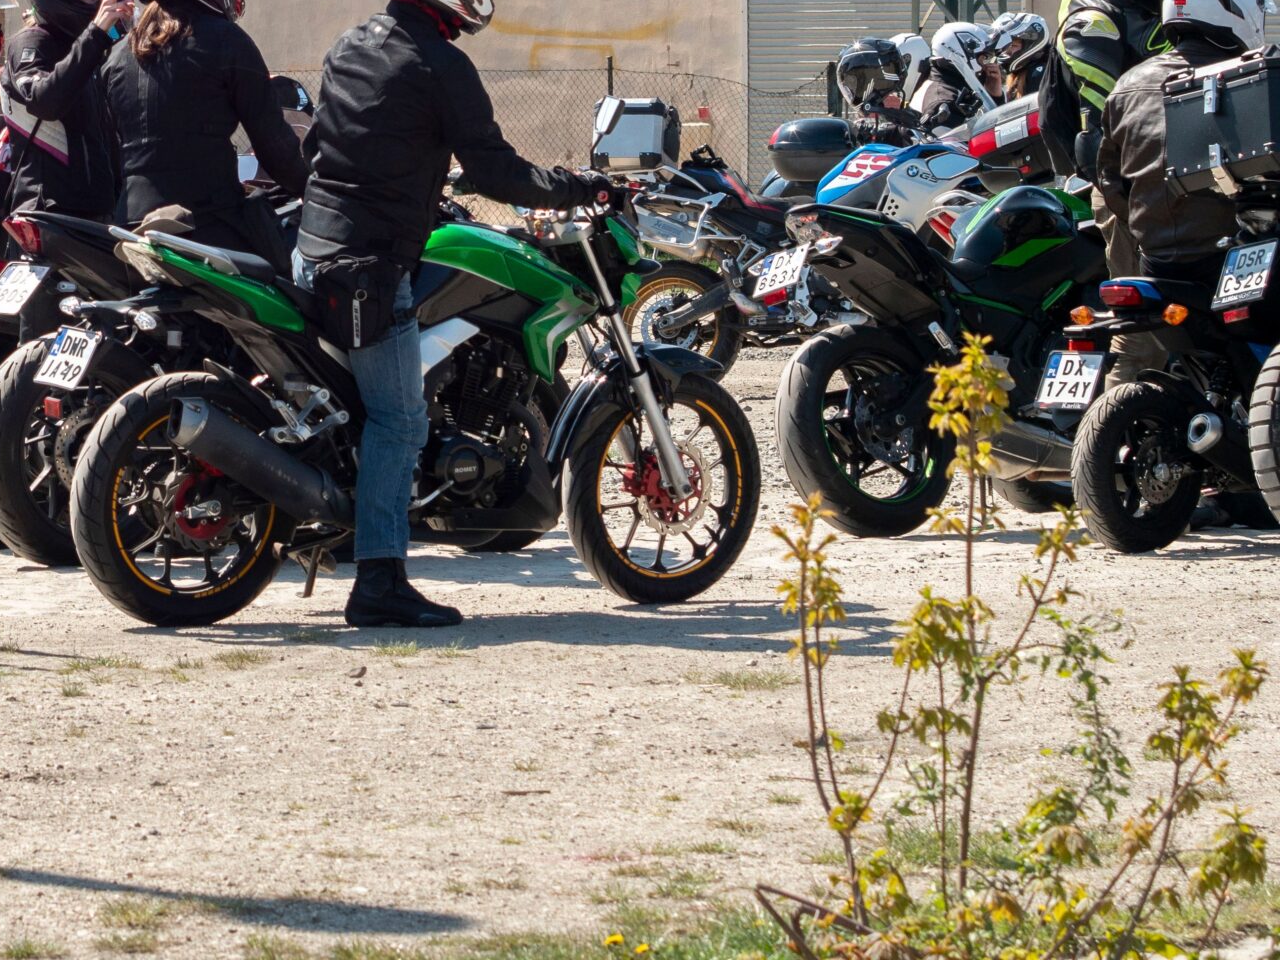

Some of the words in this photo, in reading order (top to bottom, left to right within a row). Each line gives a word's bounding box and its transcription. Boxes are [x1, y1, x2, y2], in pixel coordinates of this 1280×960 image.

[775, 253, 794, 270] DX
[1236, 249, 1265, 270] DSR
[759, 266, 798, 290] 883X
[1223, 268, 1266, 293] CS26
[61, 335, 89, 358] DWR
[40, 360, 81, 382] JA49
[1047, 368, 1056, 377] PL
[1062, 360, 1087, 376] DX
[1047, 381, 1091, 398] 174Y
